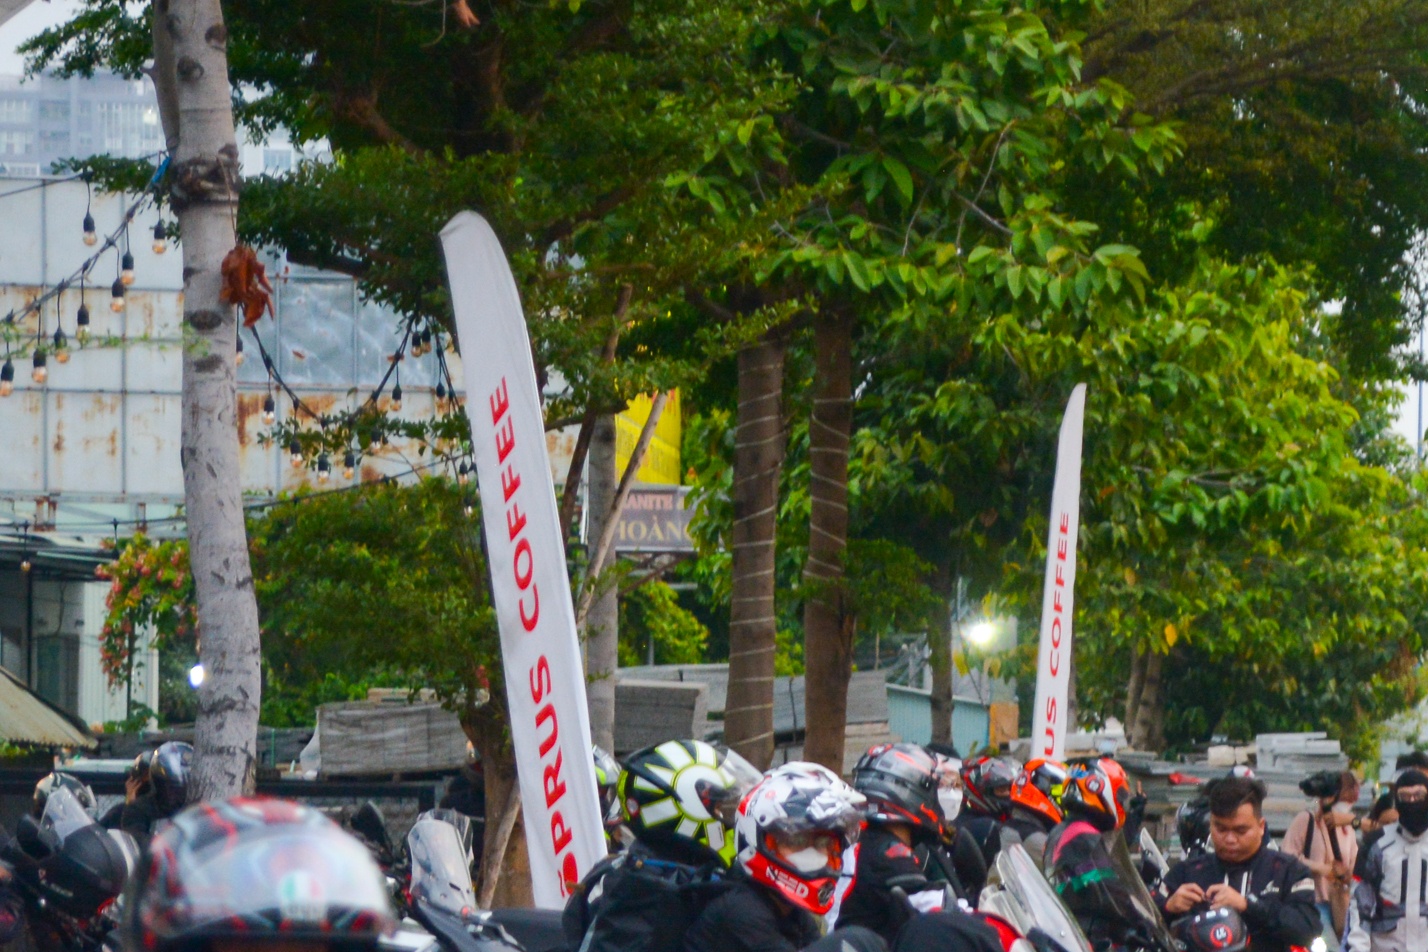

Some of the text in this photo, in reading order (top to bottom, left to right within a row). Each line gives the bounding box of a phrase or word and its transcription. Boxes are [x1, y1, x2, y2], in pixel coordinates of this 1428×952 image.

[489, 376, 541, 632] COFFEE
[1049, 511, 1070, 678] COFFEE
[766, 866, 809, 898] NEED
